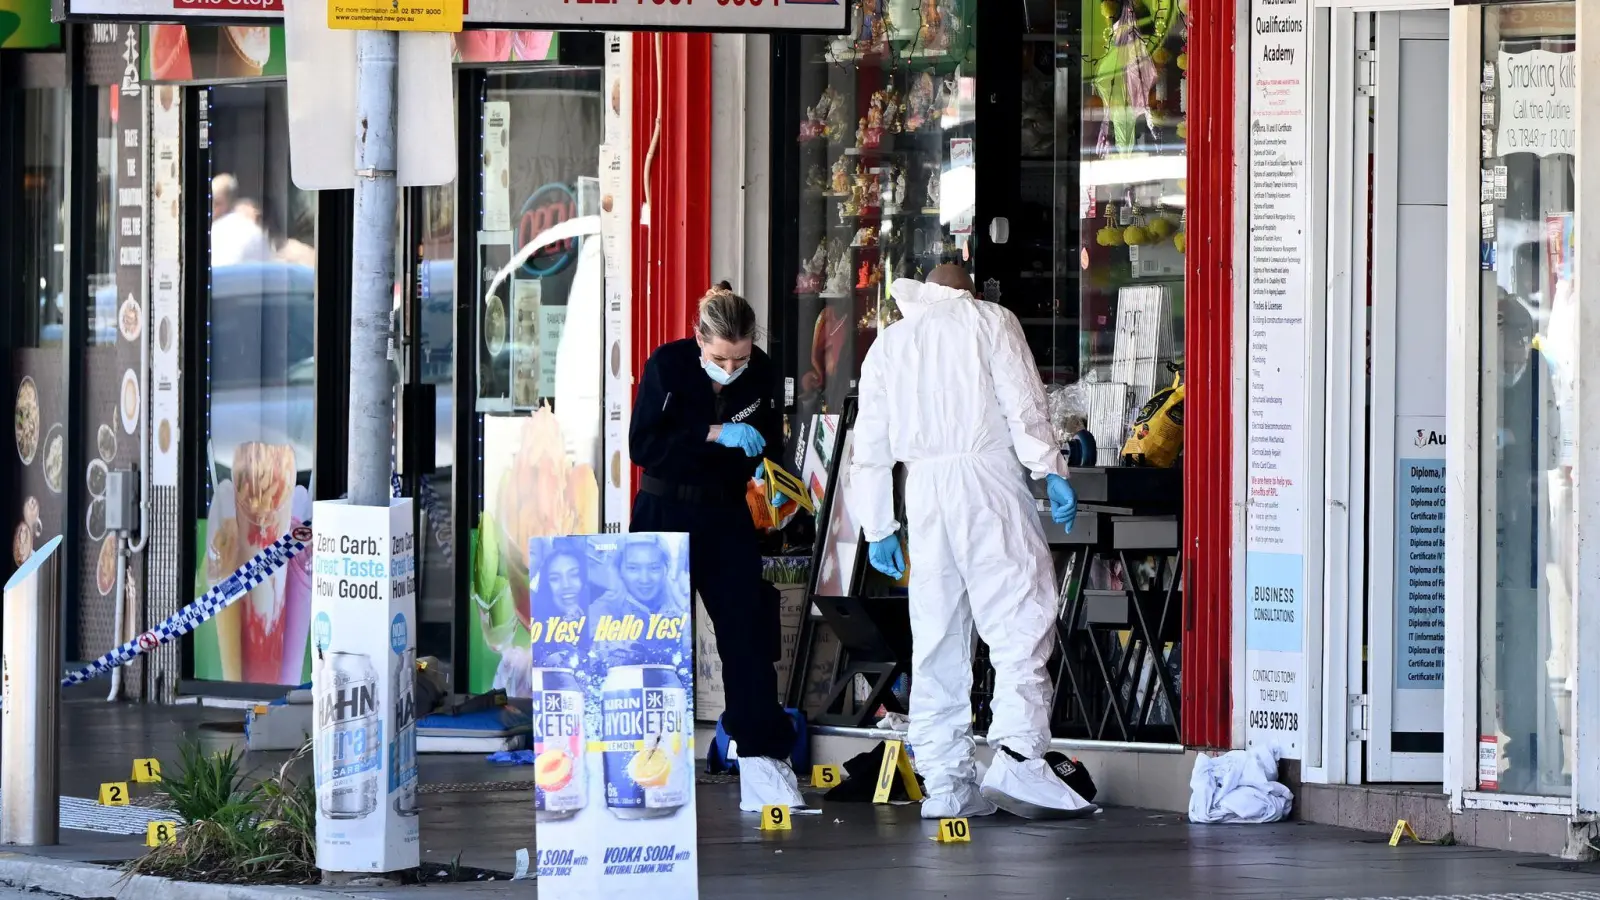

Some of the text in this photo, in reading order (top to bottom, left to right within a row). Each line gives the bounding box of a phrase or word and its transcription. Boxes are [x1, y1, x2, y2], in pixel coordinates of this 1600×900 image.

[1256, 15, 1302, 35] Qualifications
[1263, 43, 1295, 65] Academy
[1507, 57, 1556, 96] Smoking
[1513, 100, 1527, 119] Call
[1530, 101, 1543, 119] the
[1506, 129, 1516, 147] 13
[1519, 129, 1538, 148] 7848
[1550, 129, 1557, 148] 13
[1428, 431, 1447, 445] Au
[1411, 466, 1441, 479] Diploma,
[1410, 485, 1433, 494] Diploma
[1433, 485, 1439, 493] of
[1410, 498, 1432, 508] Diploma
[1433, 498, 1439, 507] of
[1410, 512, 1437, 520] Certificate
[1410, 525, 1432, 535] Diploma
[1433, 525, 1439, 533] of
[317, 532, 336, 553] Zero
[392, 536, 404, 555] Zero
[1410, 539, 1432, 548] Diploma
[1410, 552, 1436, 560] Certificate
[343, 557, 388, 577] Taste.
[1409, 566, 1432, 575] Diploma
[316, 577, 382, 600] How Good.
[392, 579, 405, 599] How
[1409, 579, 1431, 588] Diploma
[1254, 586, 1294, 603] BUSINESS
[1409, 592, 1431, 602] Diploma
[1431, 592, 1438, 600] of
[167, 604, 207, 632] POLICE
[1431, 606, 1438, 614] of
[545, 615, 586, 643] Yes!
[593, 613, 687, 642] Hello Yes!
[1408, 619, 1431, 628] Diploma
[1431, 619, 1437, 627] of
[1408, 633, 1414, 641] IT
[1408, 646, 1430, 655] Diploma
[1430, 646, 1437, 654] of
[1408, 659, 1435, 668] Certificate
[1408, 673, 1435, 681] Certificate
[604, 697, 641, 711] KIRIN
[604, 711, 682, 736] HYOKETSU
[1250, 710, 1299, 731] 0433 986738
[143, 761, 153, 777] 1
[821, 767, 834, 783] 5
[109, 786, 122, 802] 2
[770, 806, 784, 824] 9
[156, 824, 168, 841] 8
[944, 819, 967, 838] 10
[543, 849, 574, 866] SODA
[573, 854, 589, 865] with
[603, 845, 690, 864] VODKA SODA with
[554, 866, 573, 877] JUICE
[604, 863, 675, 876] NATURAL LEMON JUICE
